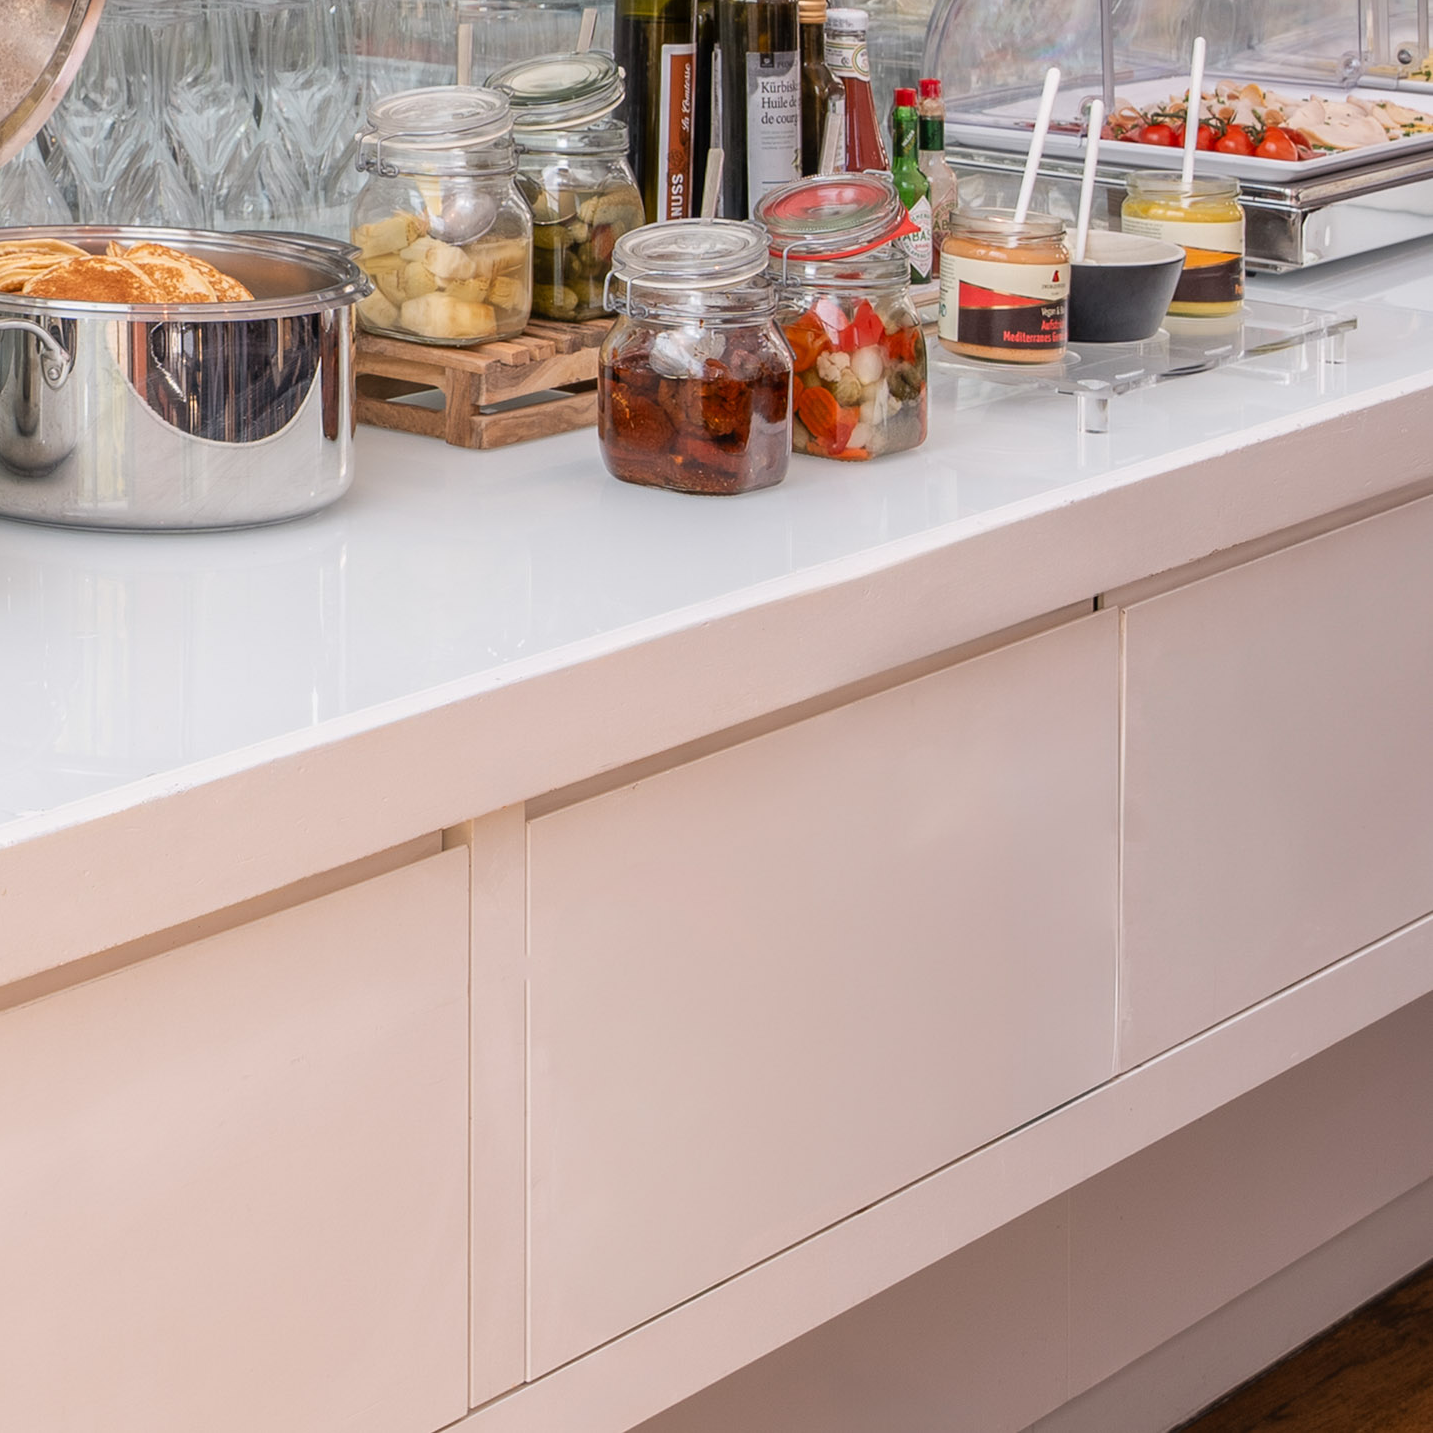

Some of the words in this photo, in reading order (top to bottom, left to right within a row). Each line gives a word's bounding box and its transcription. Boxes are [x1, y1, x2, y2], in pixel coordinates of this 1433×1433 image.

[761, 96, 788, 109] Huile
[761, 113, 774, 124] de
[670, 173, 684, 219] NUSS
[1003, 330, 1051, 343] Mediterranes
